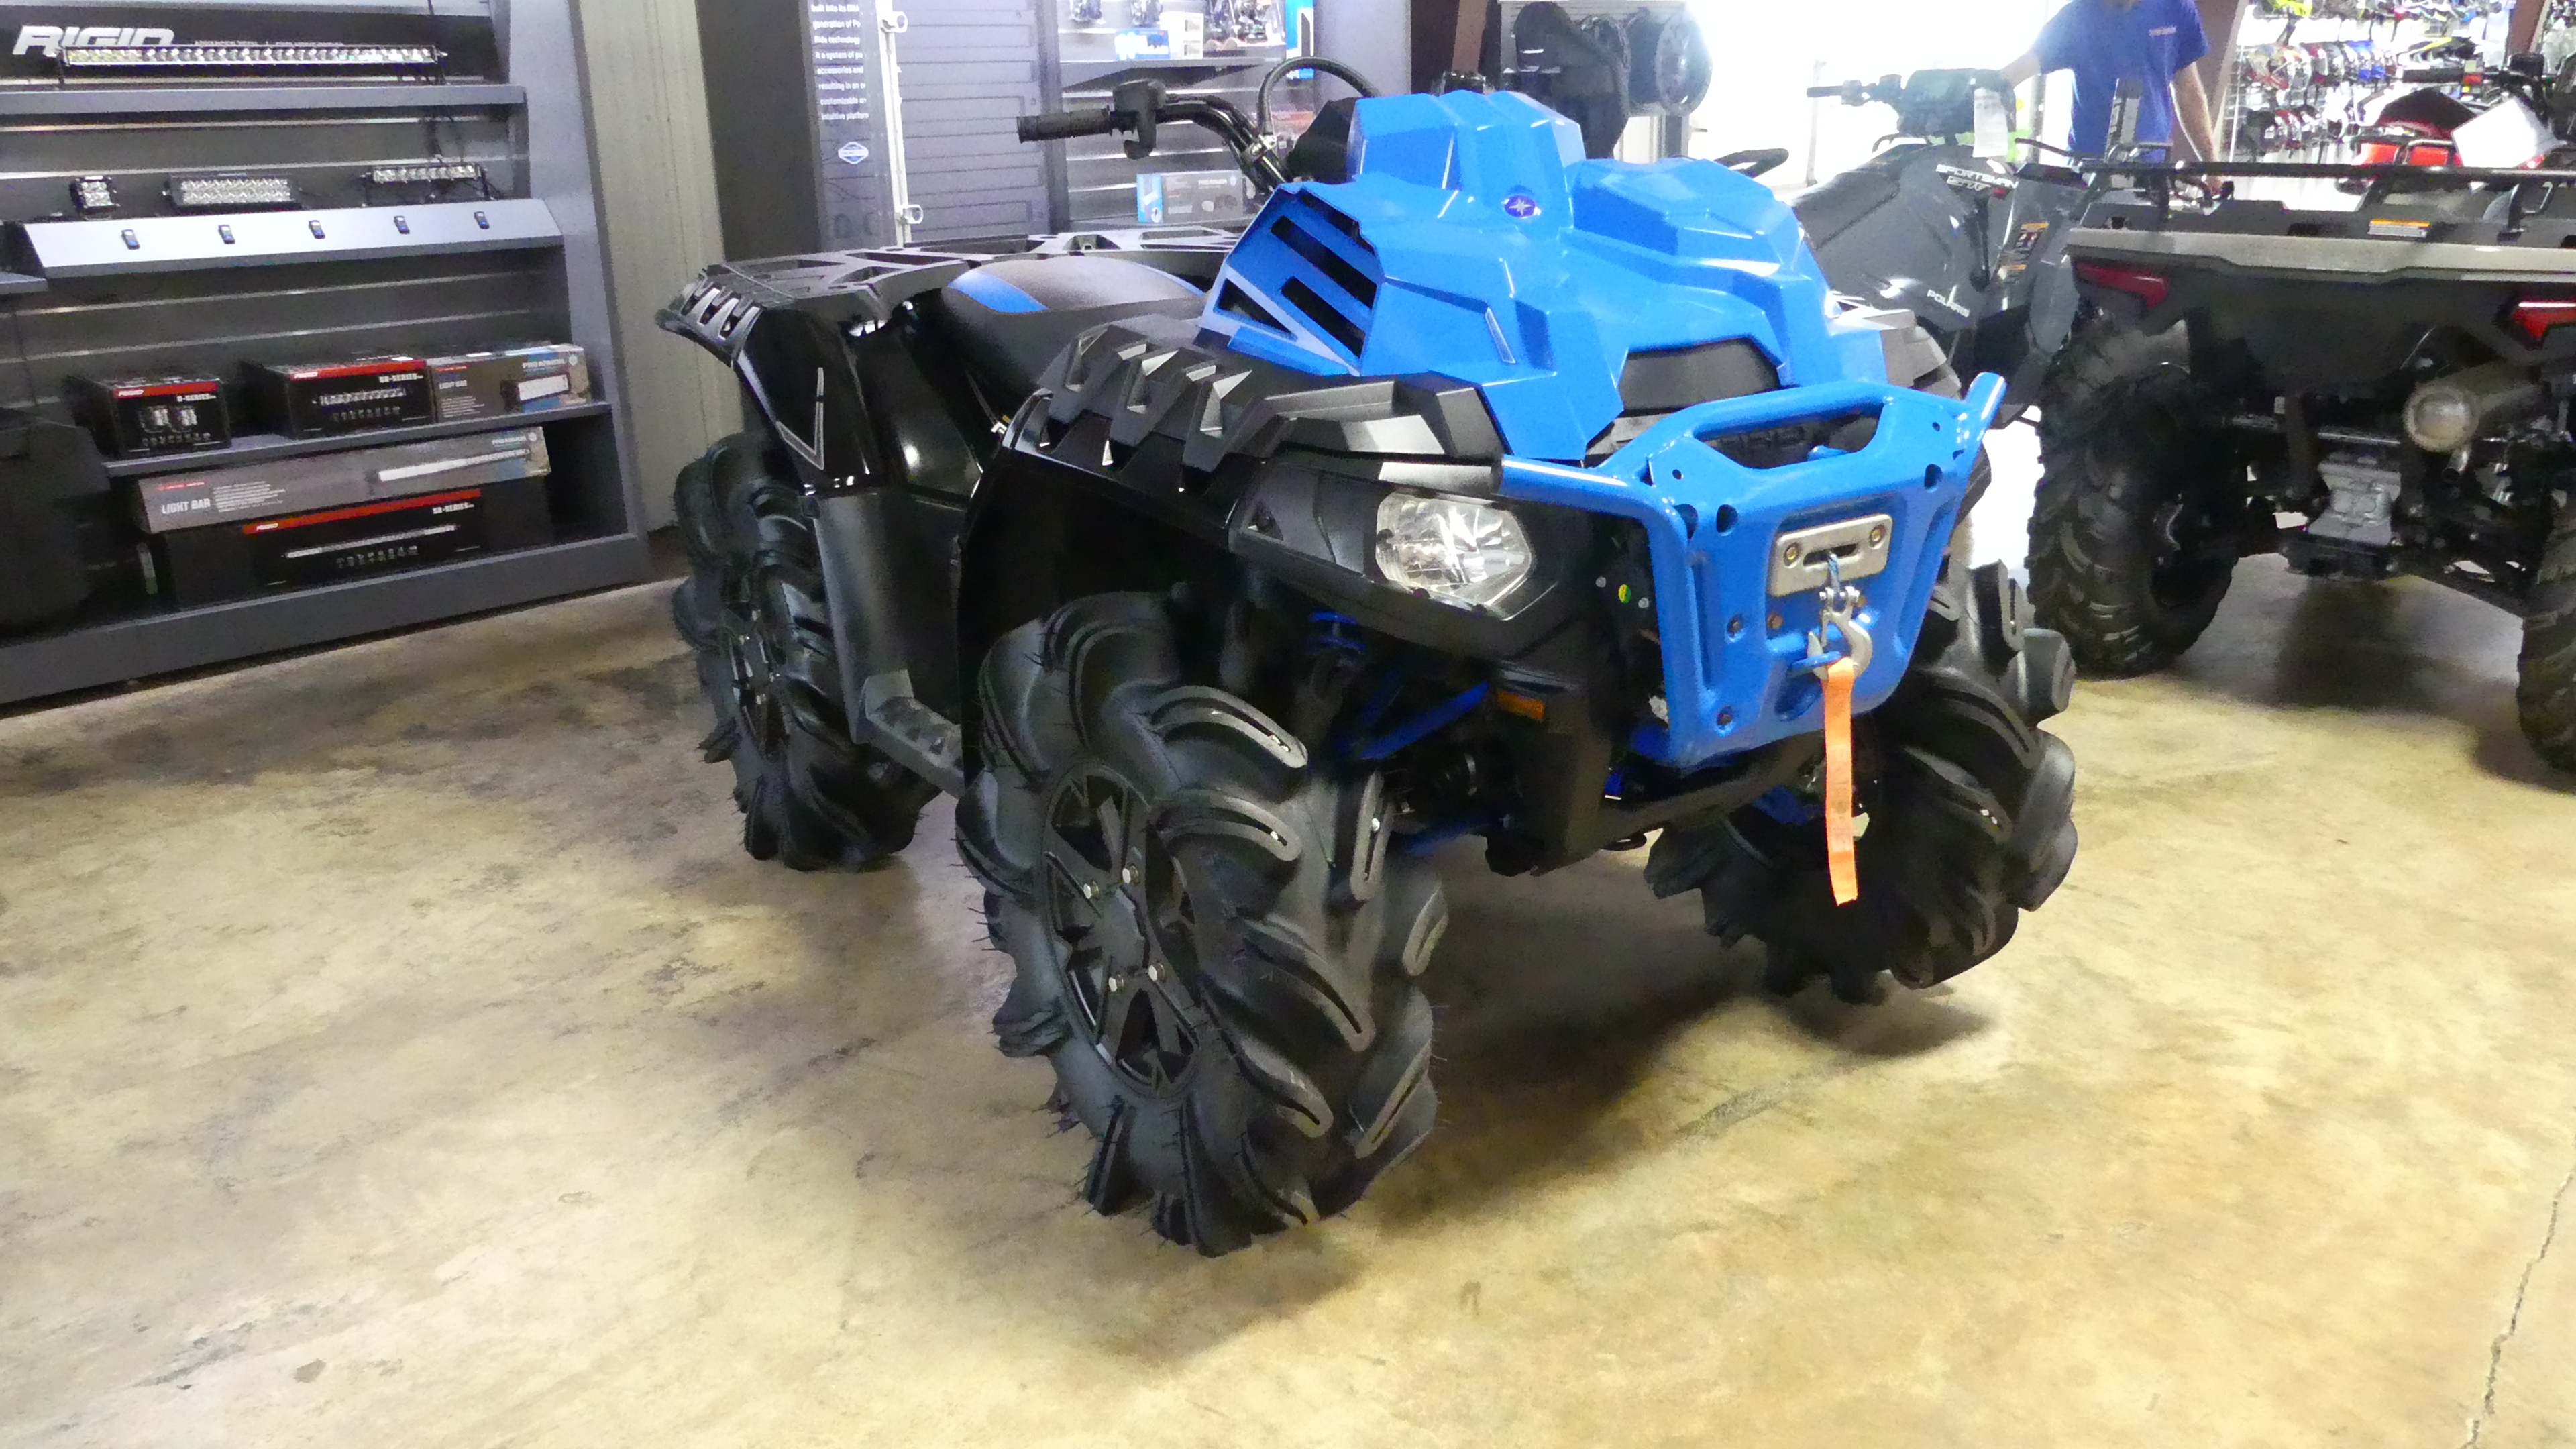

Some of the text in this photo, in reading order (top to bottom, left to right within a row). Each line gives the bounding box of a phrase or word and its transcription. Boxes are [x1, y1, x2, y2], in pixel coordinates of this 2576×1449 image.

[812, 20, 845, 30] generation
[12, 25, 174, 57] RIGID
[828, 36, 860, 45] technology
[826, 52, 847, 60] system
[817, 66, 852, 74] accessories
[818, 82, 845, 91] resulting
[820, 97, 858, 105] customizable
[1935, 164, 2019, 189] SPORTSMAN
[1927, 289, 1970, 317] POLARIS
[161, 498, 211, 515] LIGHT BAR
